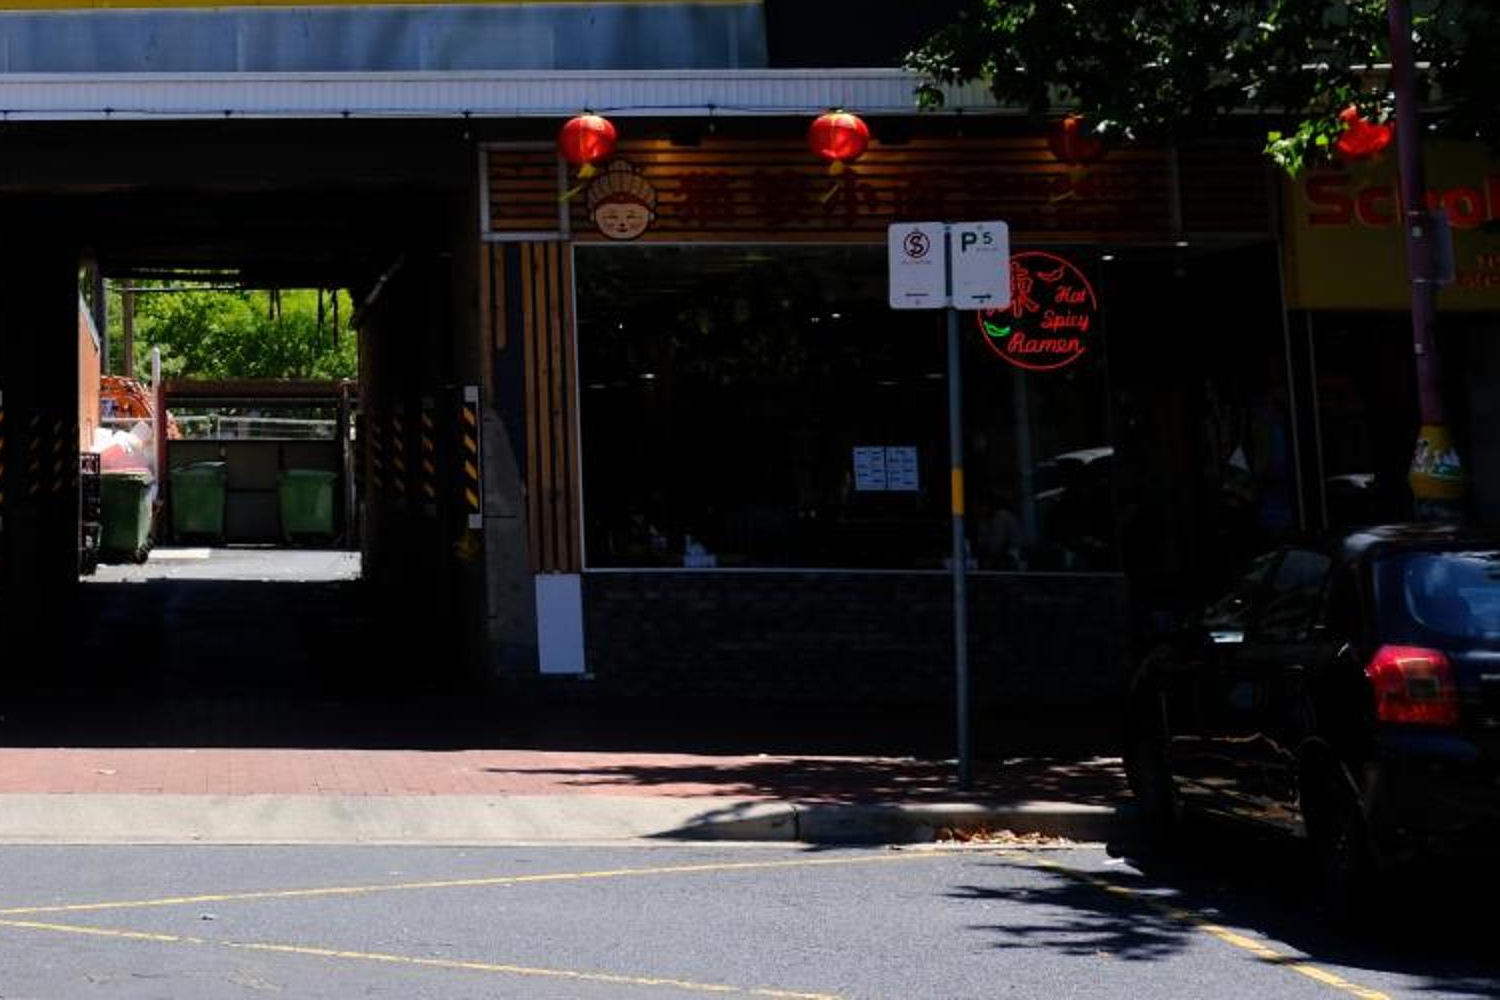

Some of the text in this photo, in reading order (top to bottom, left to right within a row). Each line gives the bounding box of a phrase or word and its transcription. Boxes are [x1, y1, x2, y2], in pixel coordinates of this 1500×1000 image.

[961, 232, 977, 252] P
[1040, 310, 1089, 333] Spicy
[1007, 332, 1083, 355] Ramen
